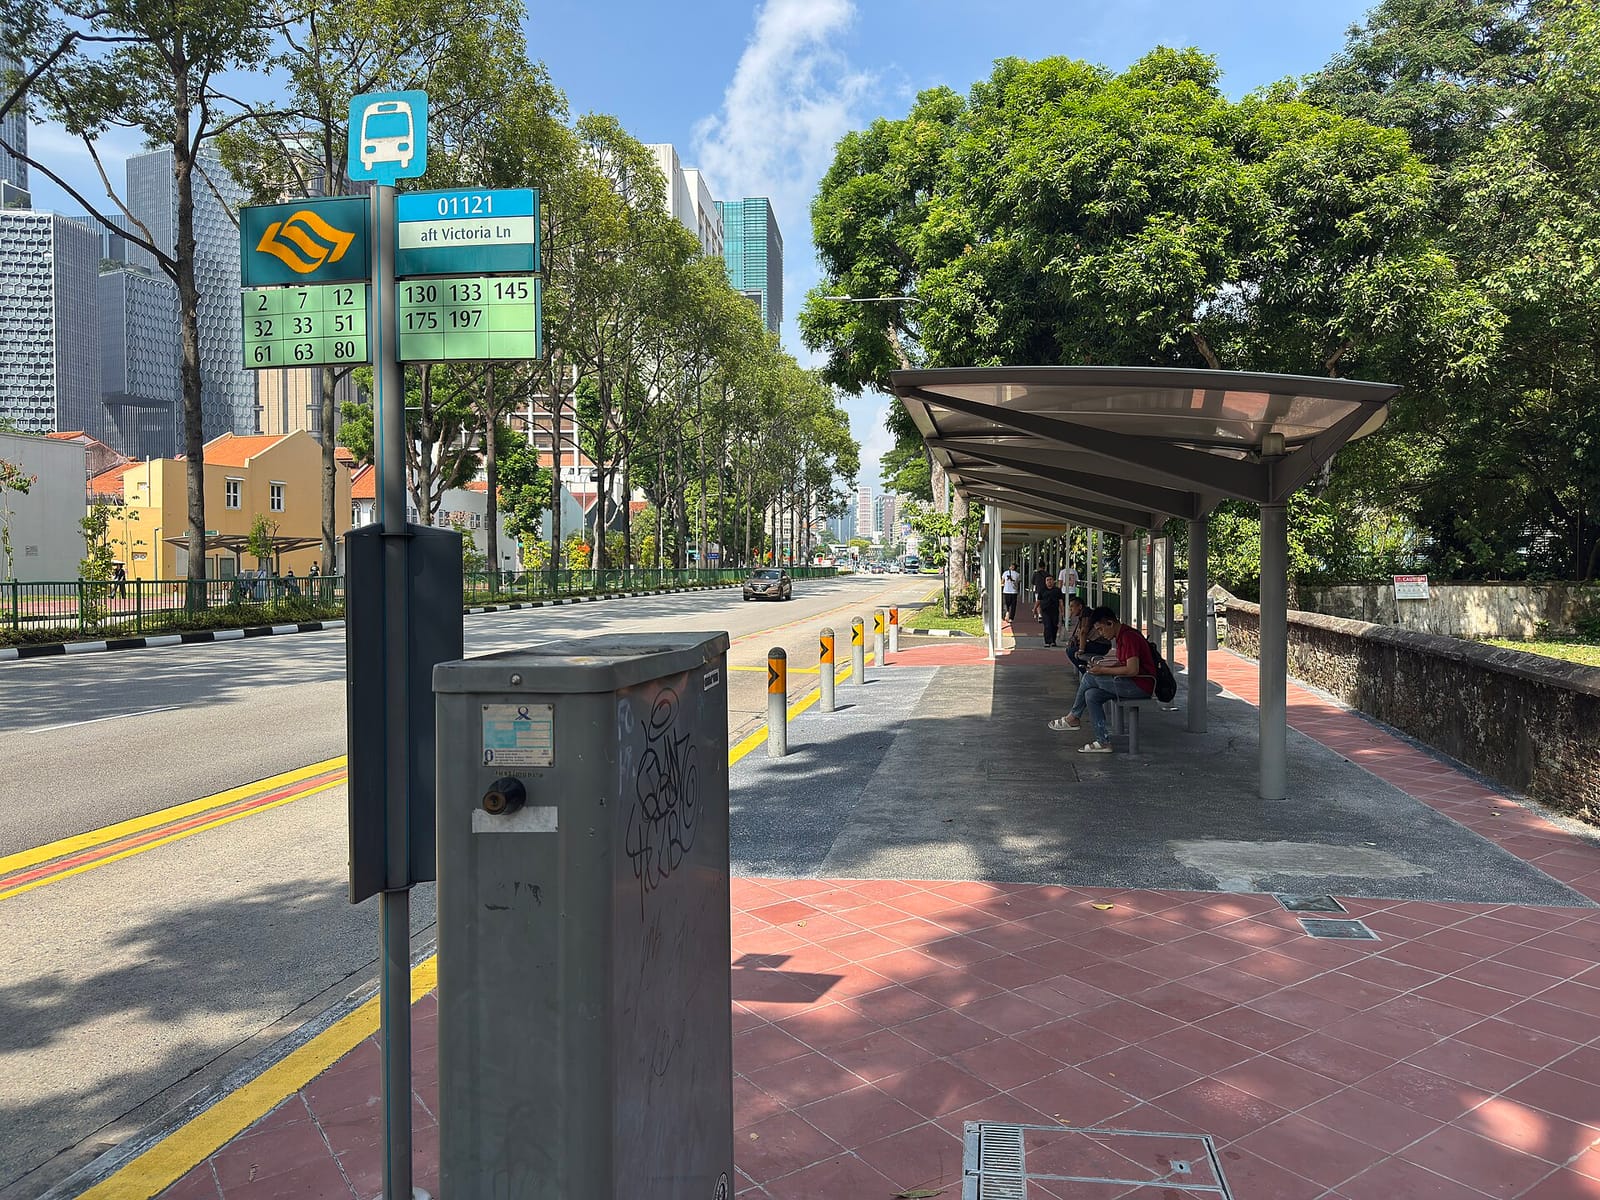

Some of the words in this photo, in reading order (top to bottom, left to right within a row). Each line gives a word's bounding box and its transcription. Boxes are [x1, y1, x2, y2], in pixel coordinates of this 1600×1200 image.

[437, 195, 493, 216] 01121
[420, 228, 438, 242] aft
[441, 226, 492, 241] Victoria
[496, 226, 511, 239] Ln
[258, 294, 268, 312] 2
[297, 292, 307, 309] 7
[333, 288, 354, 306] 12
[404, 285, 437, 304] 130
[448, 283, 482, 302] 133
[494, 281, 529, 300] 145
[254, 319, 273, 337] 32
[293, 317, 313, 335] 33
[335, 314, 353, 332] 51
[405, 311, 438, 330] 175
[448, 309, 482, 328] 197
[254, 345, 272, 363] 61
[294, 343, 314, 361] 63
[334, 340, 355, 359] 80
